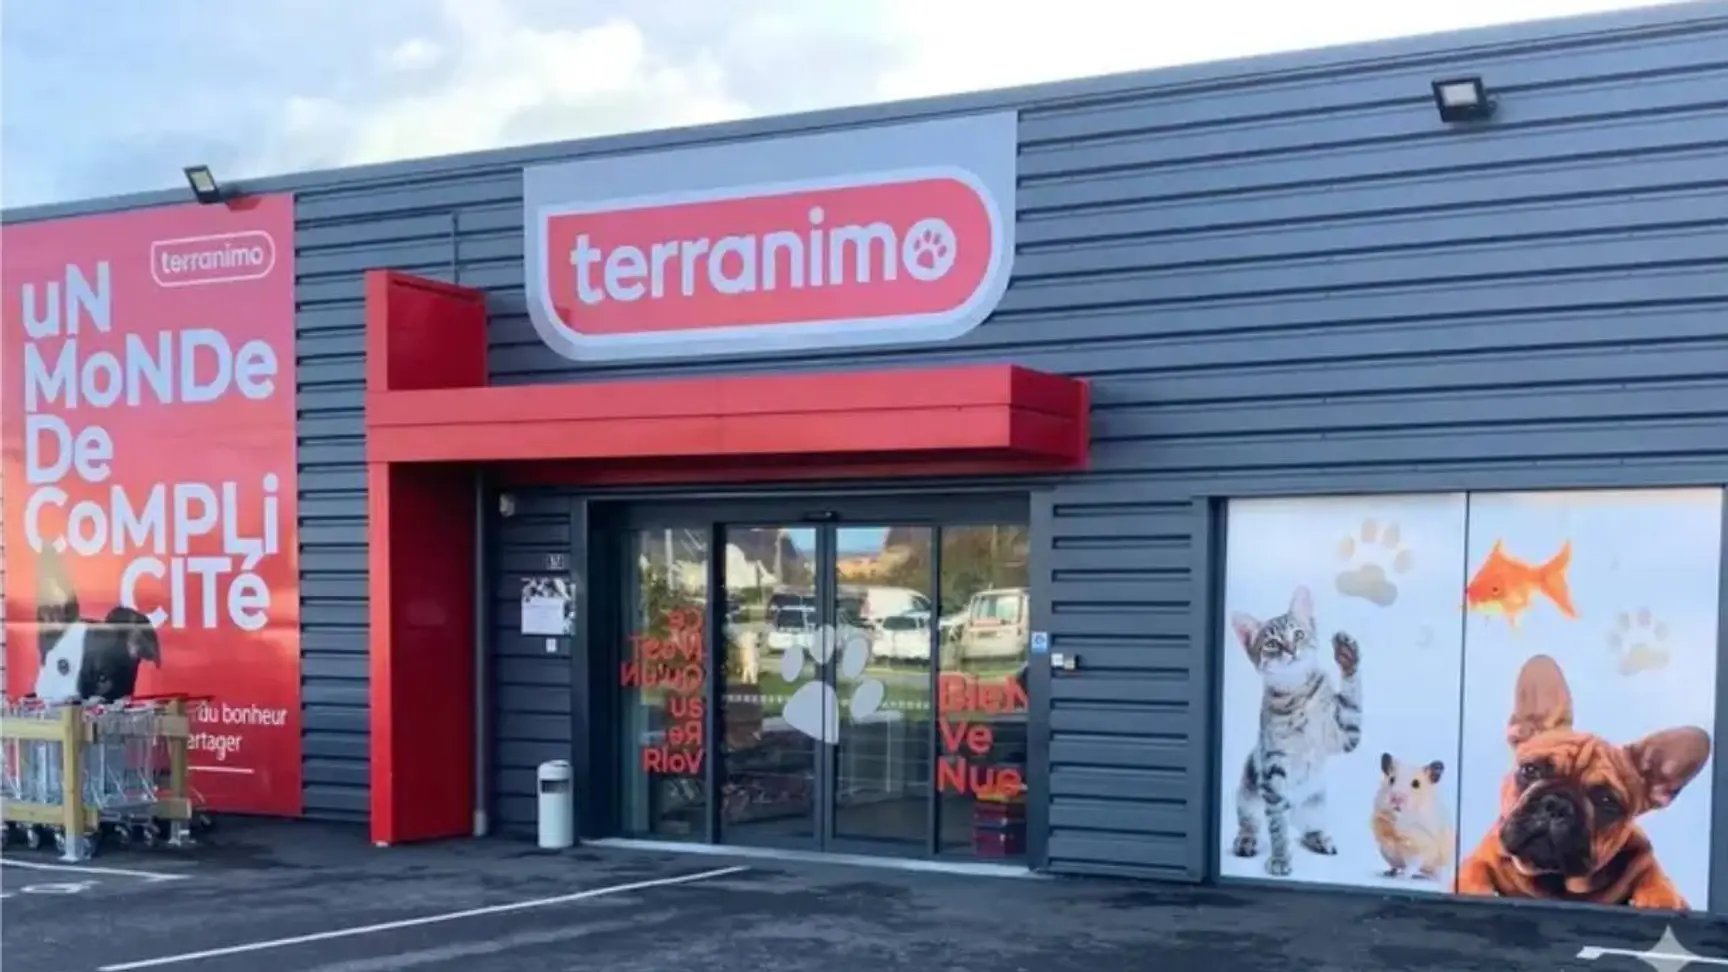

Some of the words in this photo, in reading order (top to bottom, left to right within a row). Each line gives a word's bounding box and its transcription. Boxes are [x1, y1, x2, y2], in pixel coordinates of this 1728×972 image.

[161, 243, 264, 274] terranimo
[570, 206, 957, 305] terranimo
[26, 413, 113, 484] De
[222, 702, 287, 726] bonheur
[939, 718, 993, 754] Ve
[937, 756, 1022, 798] Nue
